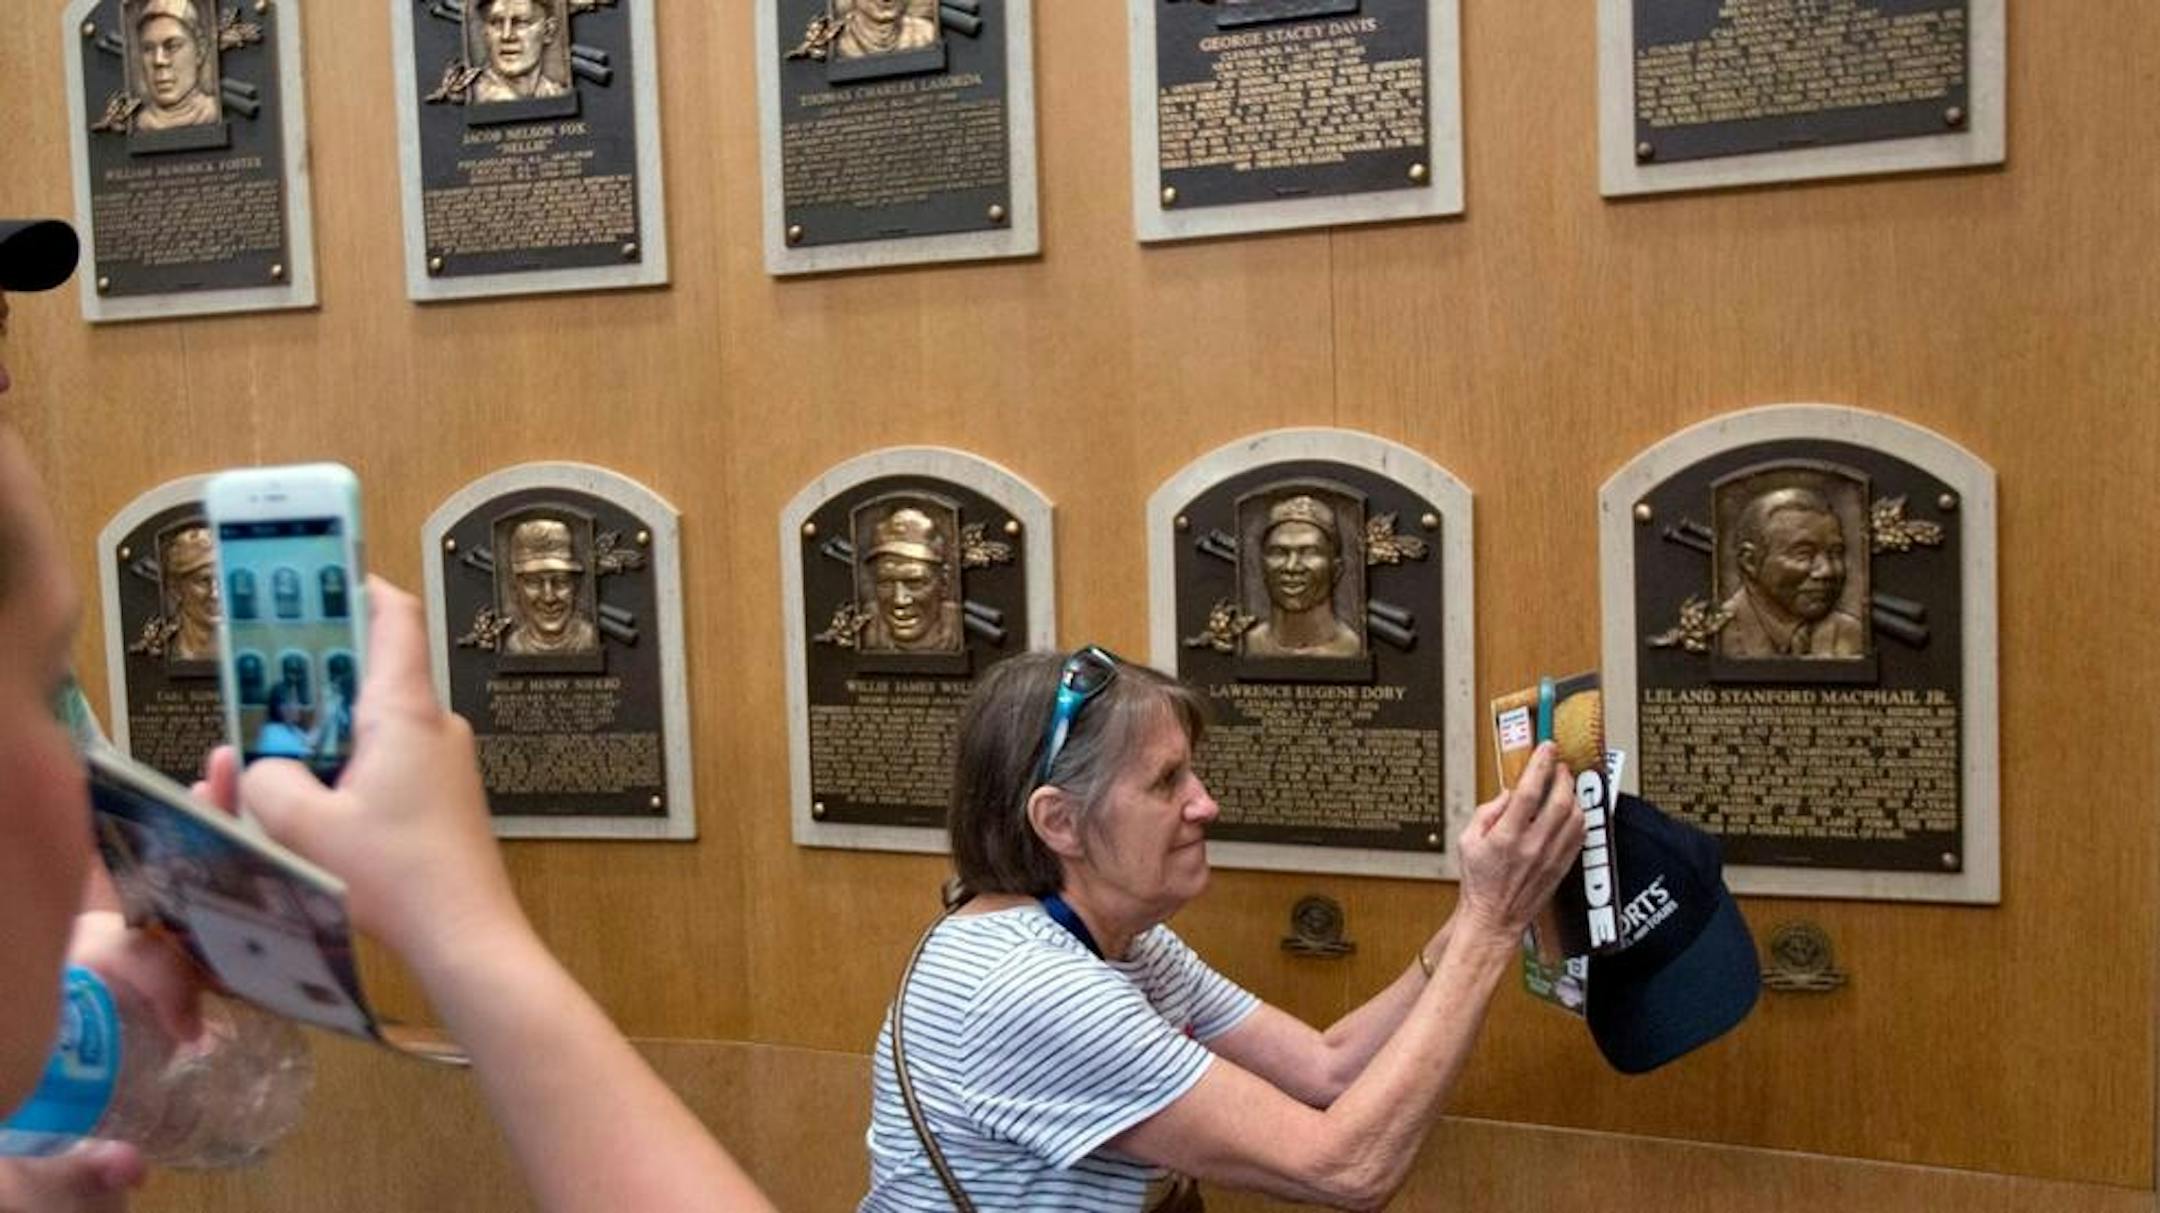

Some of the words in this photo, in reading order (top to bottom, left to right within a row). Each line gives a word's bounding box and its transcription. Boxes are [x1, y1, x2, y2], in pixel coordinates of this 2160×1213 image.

[1199, 32, 1263, 52] GEORGE
[1265, 25, 1324, 44] STACEY
[1328, 17, 1378, 37] DAVIS
[801, 89, 852, 107] THOMAS
[855, 81, 915, 100] CHARLES
[919, 74, 983, 93] LASORDA
[462, 129, 502, 145] JACOB
[506, 125, 555, 140] NELSON
[559, 121, 587, 136] FOX
[105, 166, 153, 180] WILLIAM
[487, 680, 524, 692] PHILIP
[529, 679, 567, 691] HENRY
[846, 680, 889, 693] WILLIE
[894, 680, 935, 693] JAMES
[1209, 684, 1292, 699] LAWRENCE
[1296, 685, 1358, 699] EUGENE
[1361, 686, 1407, 700] DOBY
[1645, 689, 1717, 704] LELAND
[1720, 689, 1817, 704] STANFORD
[1821, 690, 1920, 704] MACPHAIL
[1925, 690, 1953, 705] JR.
[1576, 769, 1617, 948] GUIDE
[1618, 880, 1669, 936] ORTS
